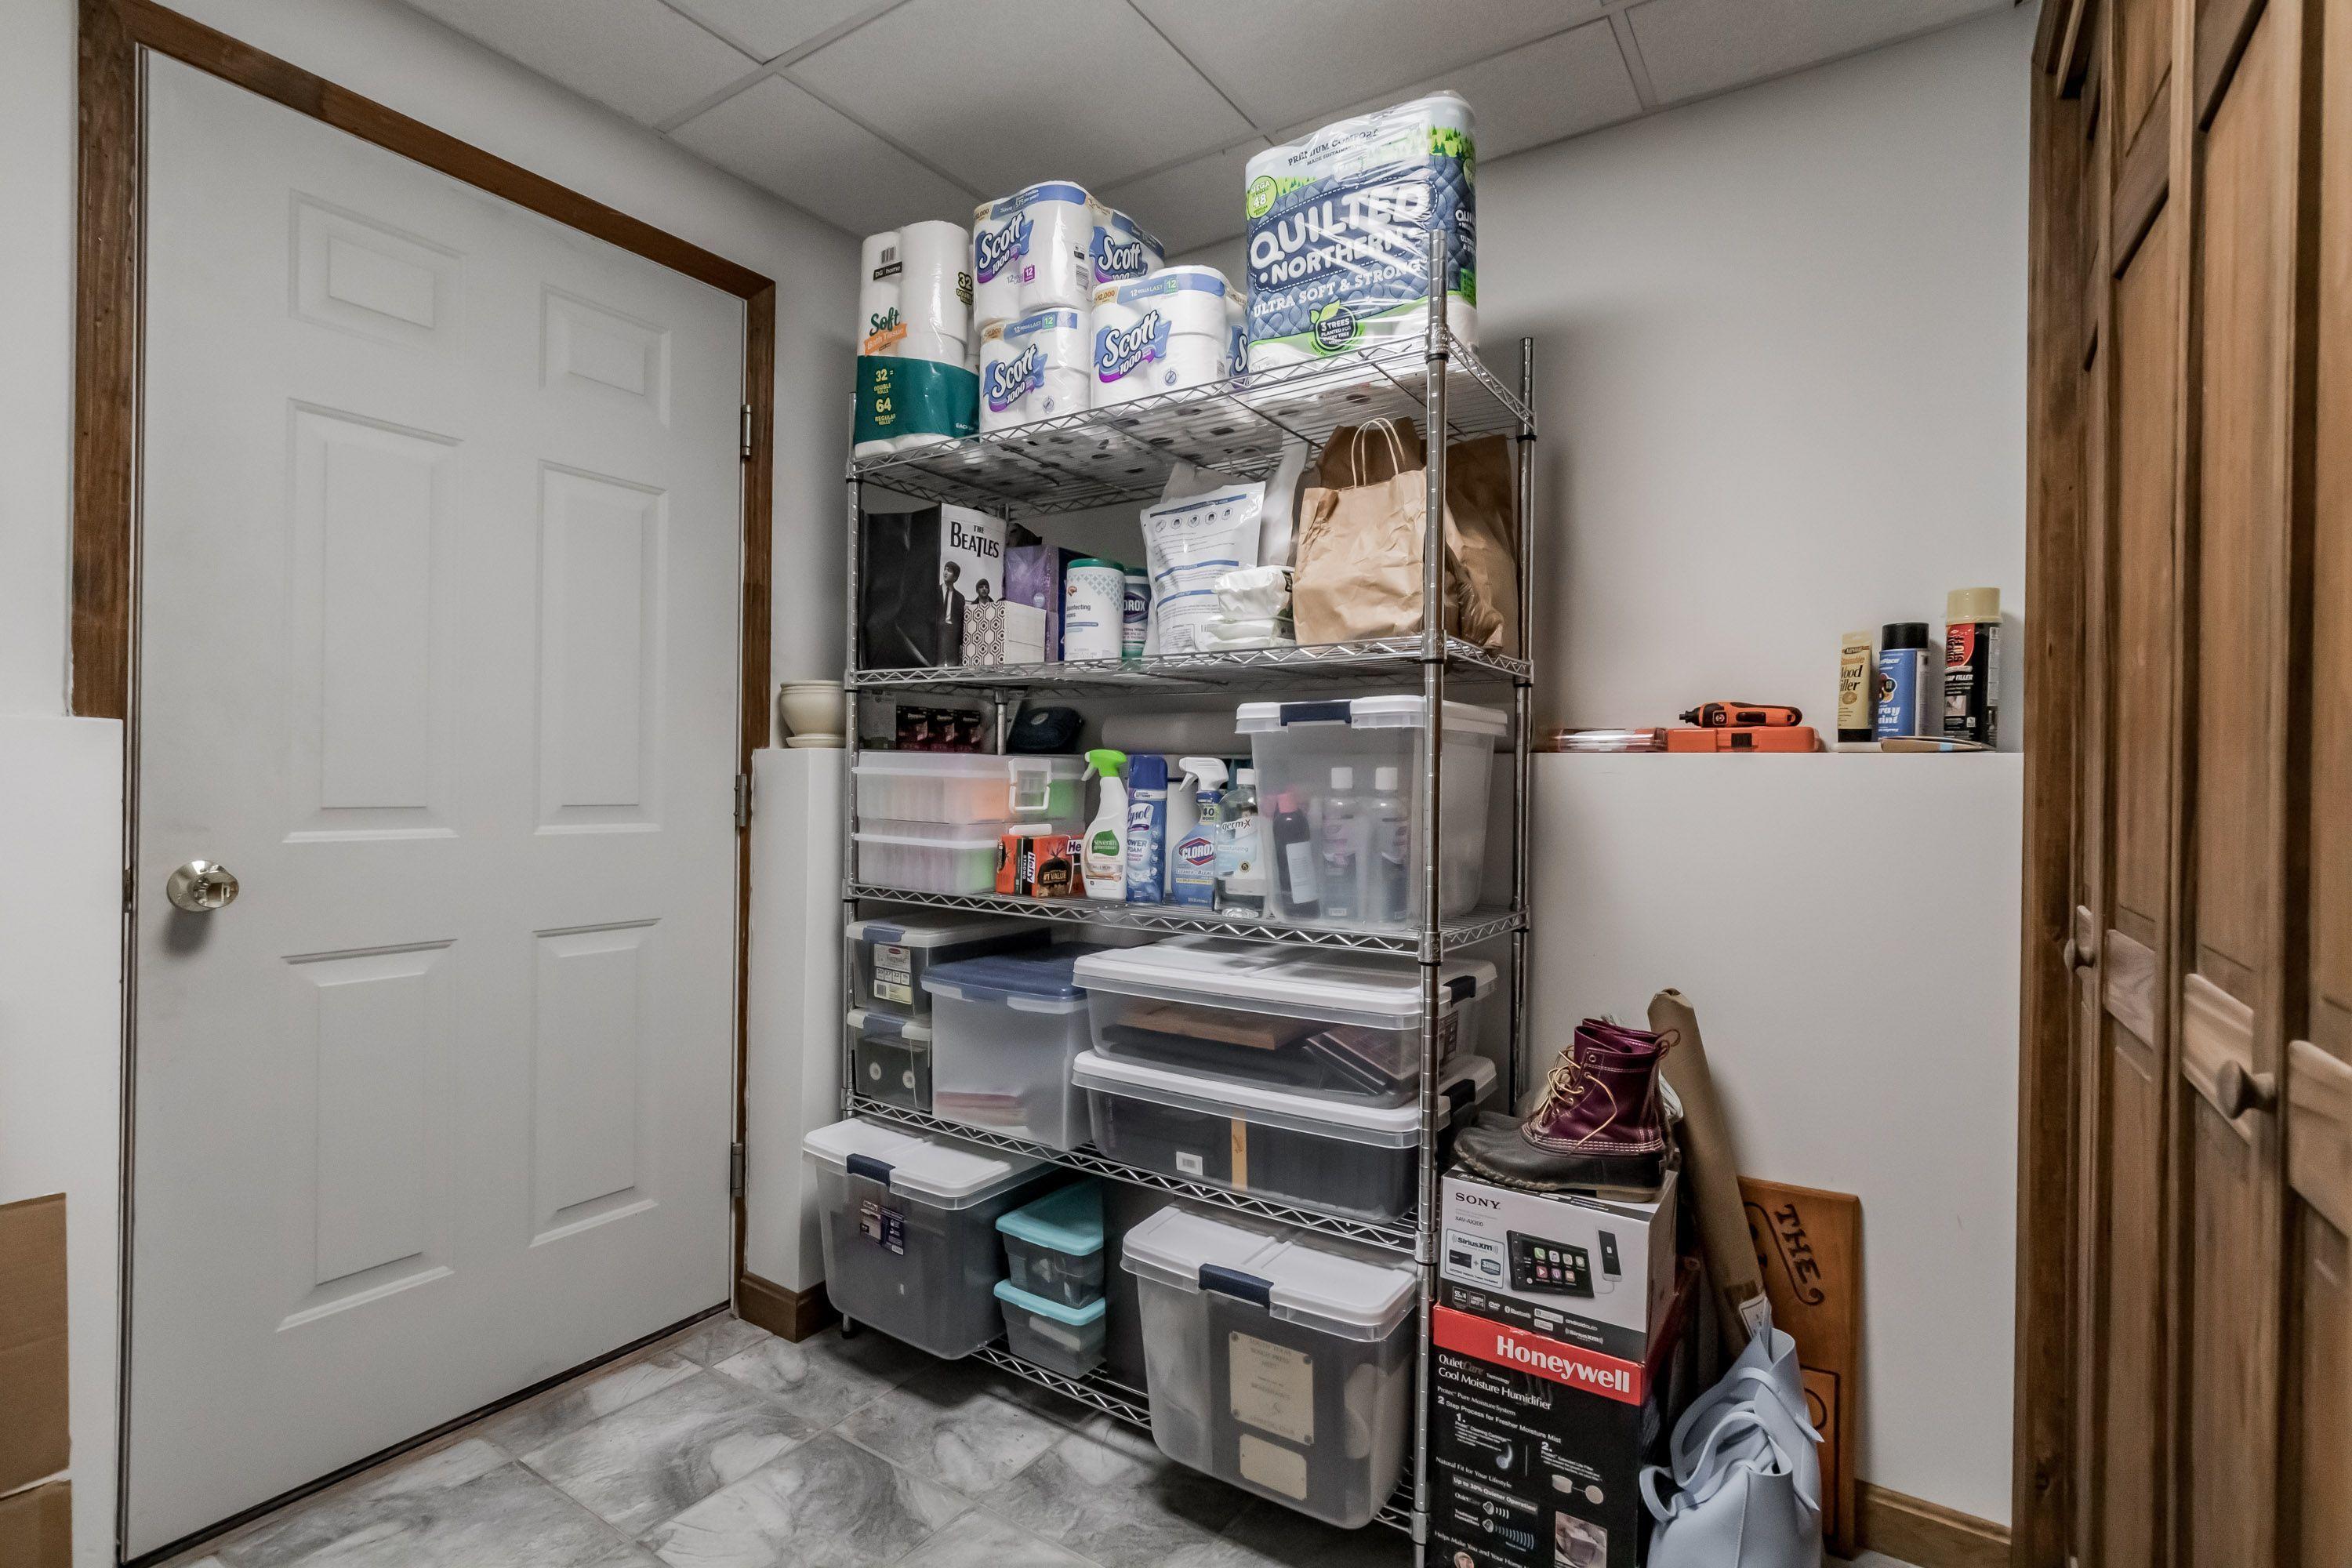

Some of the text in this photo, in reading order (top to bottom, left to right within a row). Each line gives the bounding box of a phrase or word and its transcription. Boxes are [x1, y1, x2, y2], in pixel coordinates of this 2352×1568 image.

[1254, 193, 1267, 208] 48
[1250, 183, 1431, 269] QUILTED
[978, 211, 1023, 269] Scott
[992, 250, 1010, 274] 1000
[1098, 236, 1141, 270] Scott
[958, 273, 973, 291] 32
[1025, 267, 1033, 277] 12
[956, 289, 973, 299] DOUBL
[1167, 279, 1176, 289] 12
[1254, 260, 1421, 318] ULTRA SOFT & STRONG
[869, 307, 901, 336] Soft
[1044, 316, 1054, 325] 12
[1320, 318, 1350, 332] 3 TREES
[867, 337, 883, 350] Bath
[884, 328, 904, 340] Tissue
[1102, 310, 1158, 368] Scott
[1321, 328, 1342, 337] PLANTED
[991, 344, 1036, 398] Scott
[1119, 350, 1142, 375] 1000
[876, 368, 887, 382] 32
[874, 383, 891, 392] DOUBLE
[1007, 381, 1025, 404] 1000
[876, 397, 891, 412] 64
[950, 521, 1000, 558] BEATLES
[974, 525, 985, 534] THE
[1840, 680, 1860, 691] iller
[1878, 706, 1900, 717] ray
[1222, 818, 1250, 830] germ-X
[1051, 871, 1066, 880] VALUE
[1456, 1192, 1501, 1209] SONY
[1456, 1216, 1483, 1227] XAV-AX200
[1774, 1203, 1821, 1284] THE
[1497, 1335, 1630, 1393] Honeywell
[1439, 1367, 1551, 1410] Cool Moisture Humidifier
[1457, 1392, 1471, 1402] Pure
[1471, 1397, 1497, 1410] Moisture
[1496, 1404, 1516, 1416] System
[1437, 1396, 1445, 1405] 2
[1446, 1400, 1460, 1410] Step
[1461, 1406, 1485, 1418] Process
[1495, 1417, 1518, 1429] Fresher
[1519, 1424, 1547, 1439] Moisture
[1548, 1433, 1562, 1443] Mist
[1456, 1413, 1466, 1423] 1.
[1541, 1441, 1552, 1452] 2.
[1436, 1457, 1456, 1468] Natural
[1475, 1470, 1487, 1479] Your
[1454, 1477, 1462, 1486] Up
[1483, 1488, 1505, 1501] Quieter
[1506, 1497, 1537, 1512] Operation
[1434, 1530, 1523, 1568] Helps Make You and Your Home
